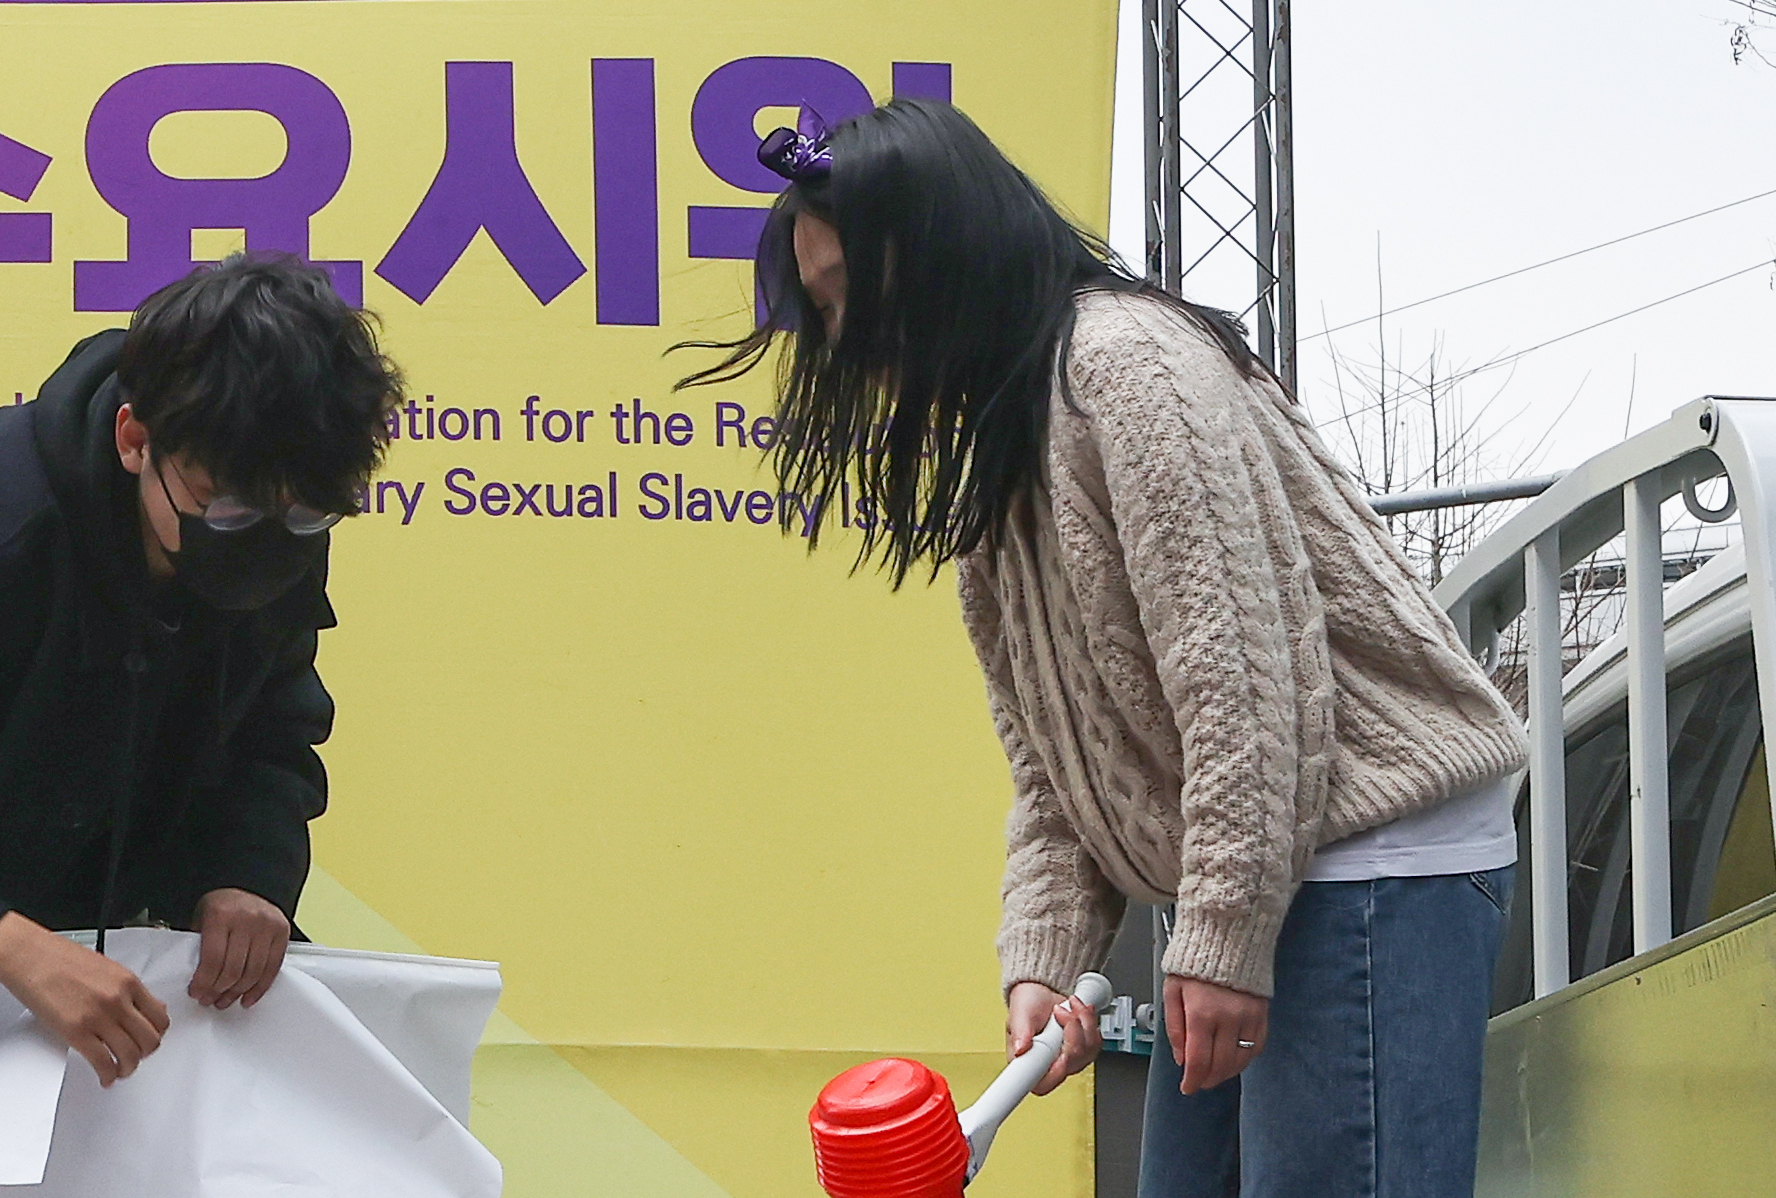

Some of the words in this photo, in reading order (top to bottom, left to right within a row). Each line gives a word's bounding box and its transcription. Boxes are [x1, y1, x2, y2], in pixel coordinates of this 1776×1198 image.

[520, 396, 594, 443] for
[610, 398, 694, 447] the
[443, 467, 617, 517] Sexual
[638, 472, 823, 538] Slavery
